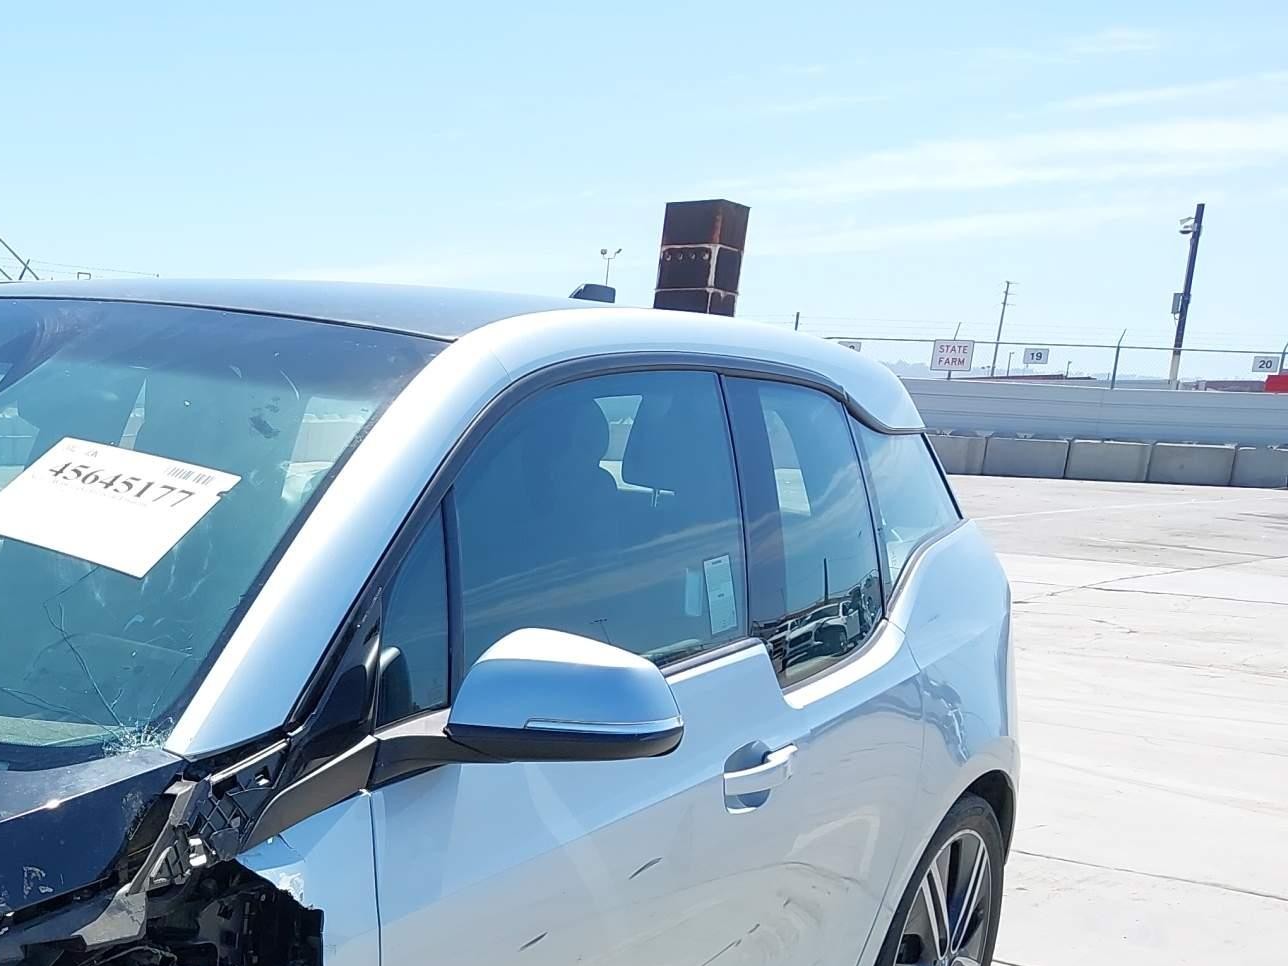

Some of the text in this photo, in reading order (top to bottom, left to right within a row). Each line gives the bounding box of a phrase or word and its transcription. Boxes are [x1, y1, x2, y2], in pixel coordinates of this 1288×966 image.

[938, 344, 969, 354] STATE
[1029, 351, 1043, 361] 19
[938, 357, 966, 366] FARM
[1258, 359, 1273, 369] 20
[49, 461, 196, 508] 45645177
